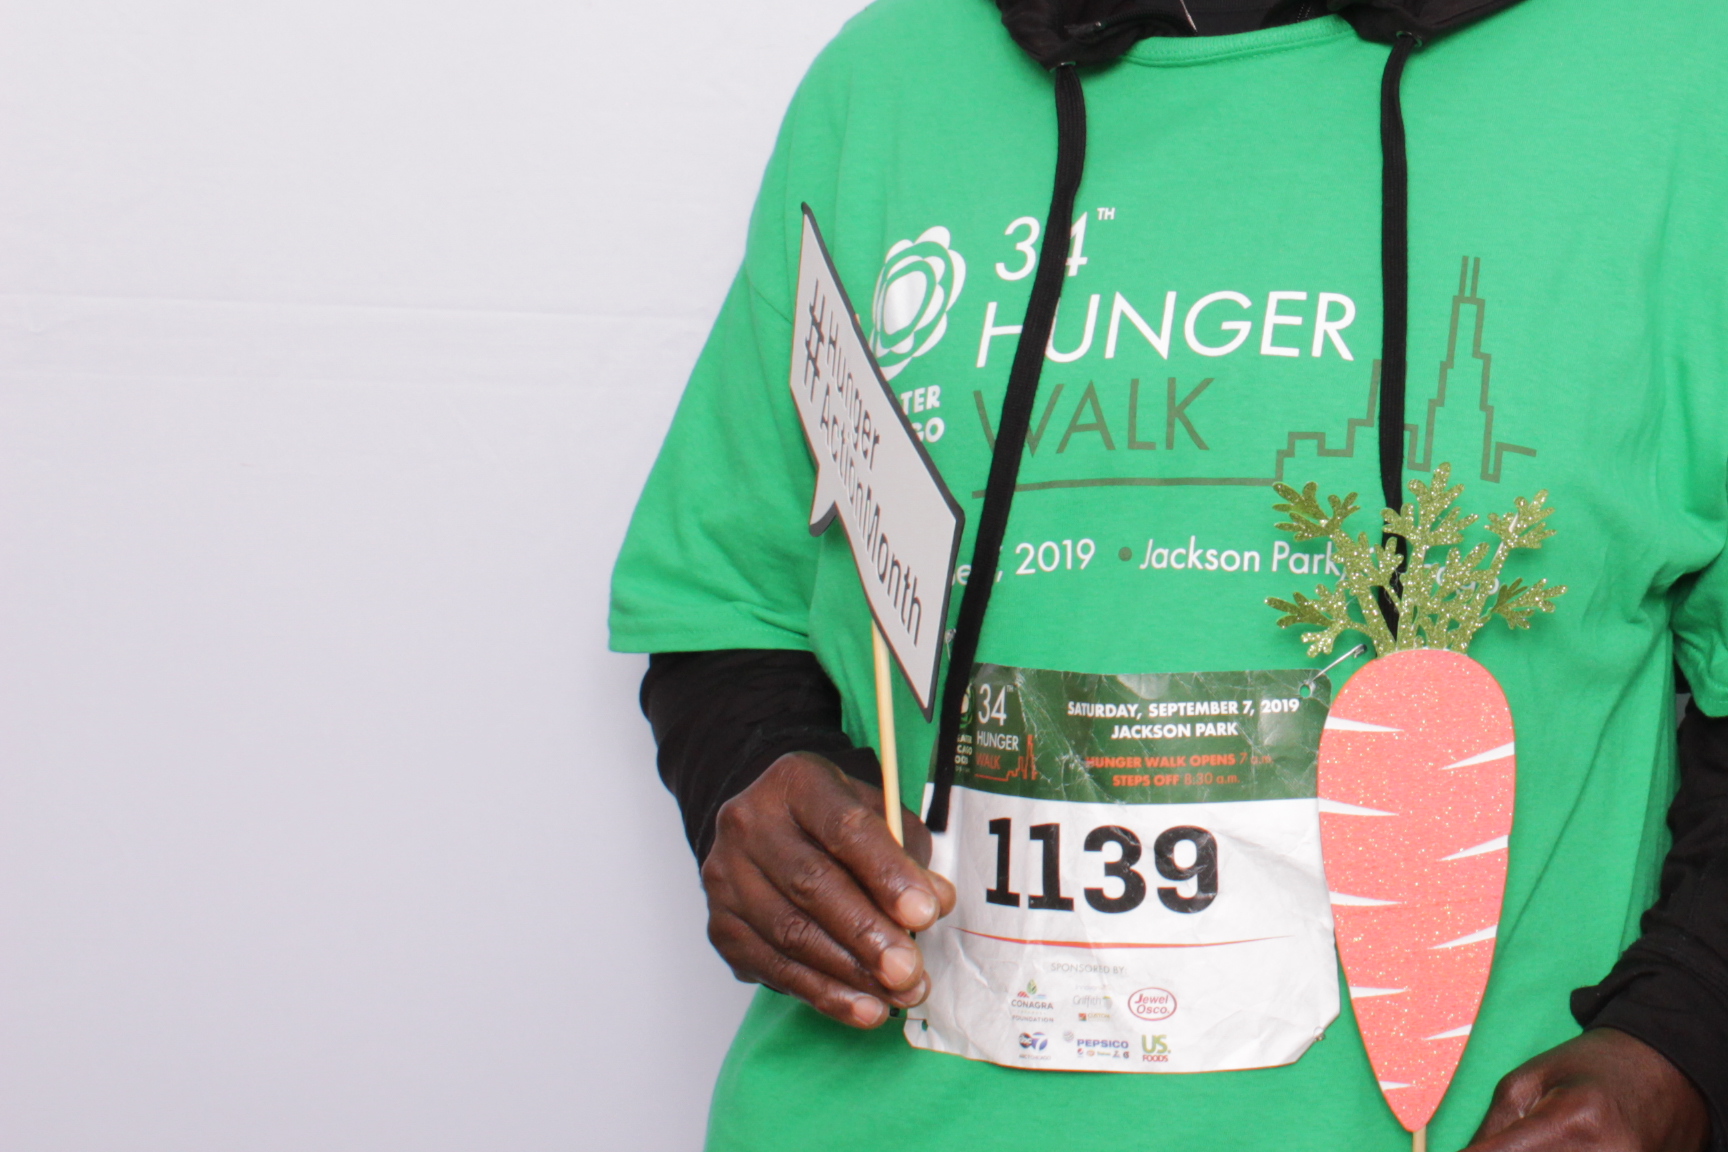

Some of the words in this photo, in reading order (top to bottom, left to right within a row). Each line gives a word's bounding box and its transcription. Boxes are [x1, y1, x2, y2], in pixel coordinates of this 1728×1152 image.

[976, 290, 1357, 369] HUNGER
[972, 376, 1215, 457] WALK
[1014, 538, 1096, 577] 2019
[1139, 535, 1261, 572] Jackson
[1067, 700, 1143, 720] SATURDAY,
[1148, 700, 1239, 718] SEPTEMBER
[1242, 700, 1255, 717] 7,
[1260, 698, 1300, 714] 2019
[1110, 723, 1191, 739] JACKSON
[1195, 722, 1239, 737] PARK
[976, 730, 1020, 752] HUNGER
[975, 752, 1002, 770] WALK
[1084, 756, 1143, 769] HUNGER
[1145, 755, 1187, 768] WALK
[1189, 753, 1237, 767] OPENS
[1239, 752, 1248, 765] 7
[1112, 774, 1151, 787] STEPS
[1153, 774, 1180, 786] OFF
[1184, 773, 1213, 785] 8:30
[1216, 774, 1240, 784] a.m.
[985, 817, 1219, 915] 1139
[1051, 962, 1110, 974] SPONSORED
[1011, 999, 1054, 1010] CONAGRA
[1134, 993, 1169, 1005] Jewel
[1077, 1038, 1129, 1049] PEPSICO
[1142, 1054, 1169, 1062] FOODS
